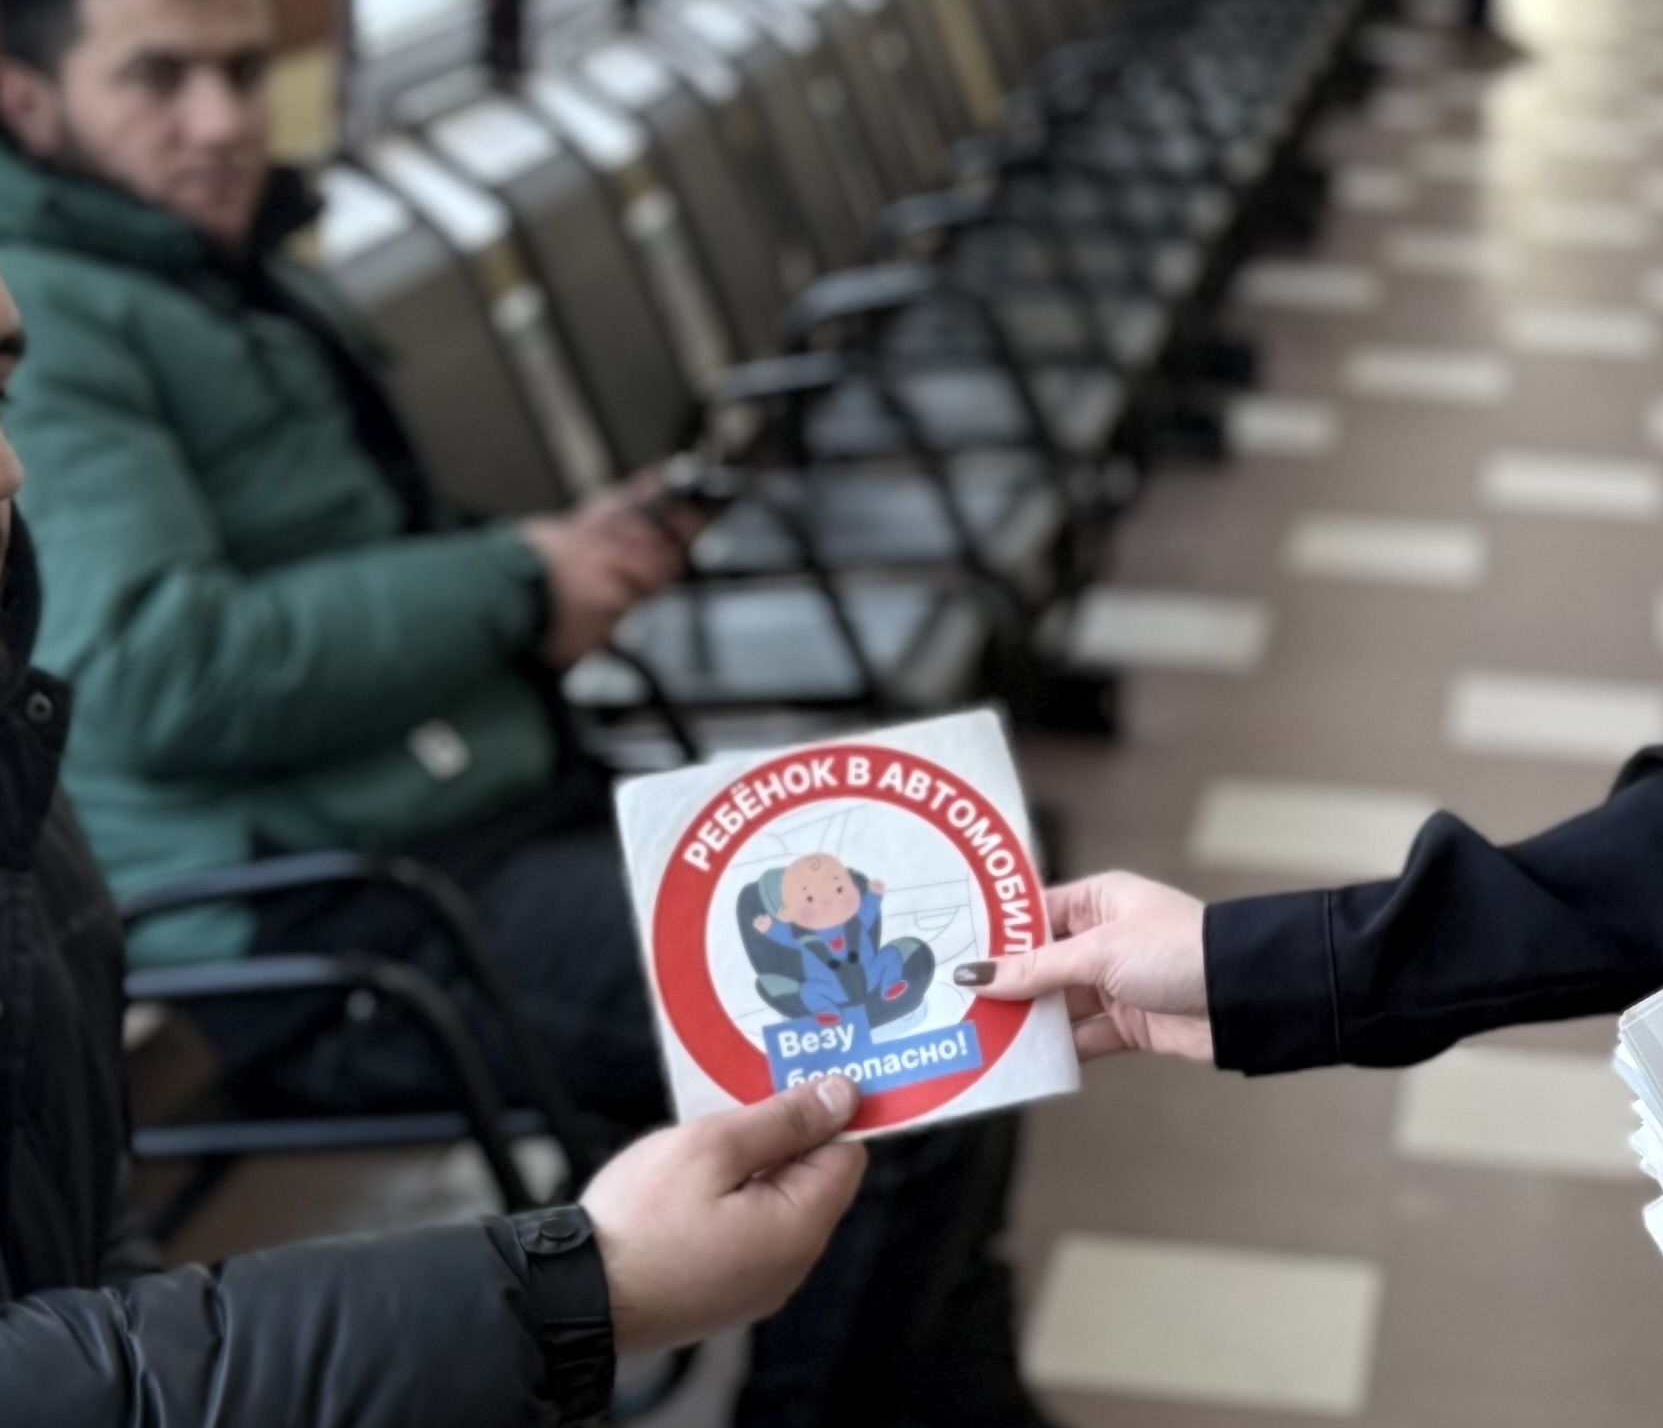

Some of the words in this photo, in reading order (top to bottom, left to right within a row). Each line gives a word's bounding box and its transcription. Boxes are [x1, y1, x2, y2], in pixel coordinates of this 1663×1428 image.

[683, 758, 838, 871] РЕБЁНОК
[846, 757, 871, 786] В
[878, 762, 1033, 954] АВТОМОБИЛ
[777, 1022, 856, 1059] Везу
